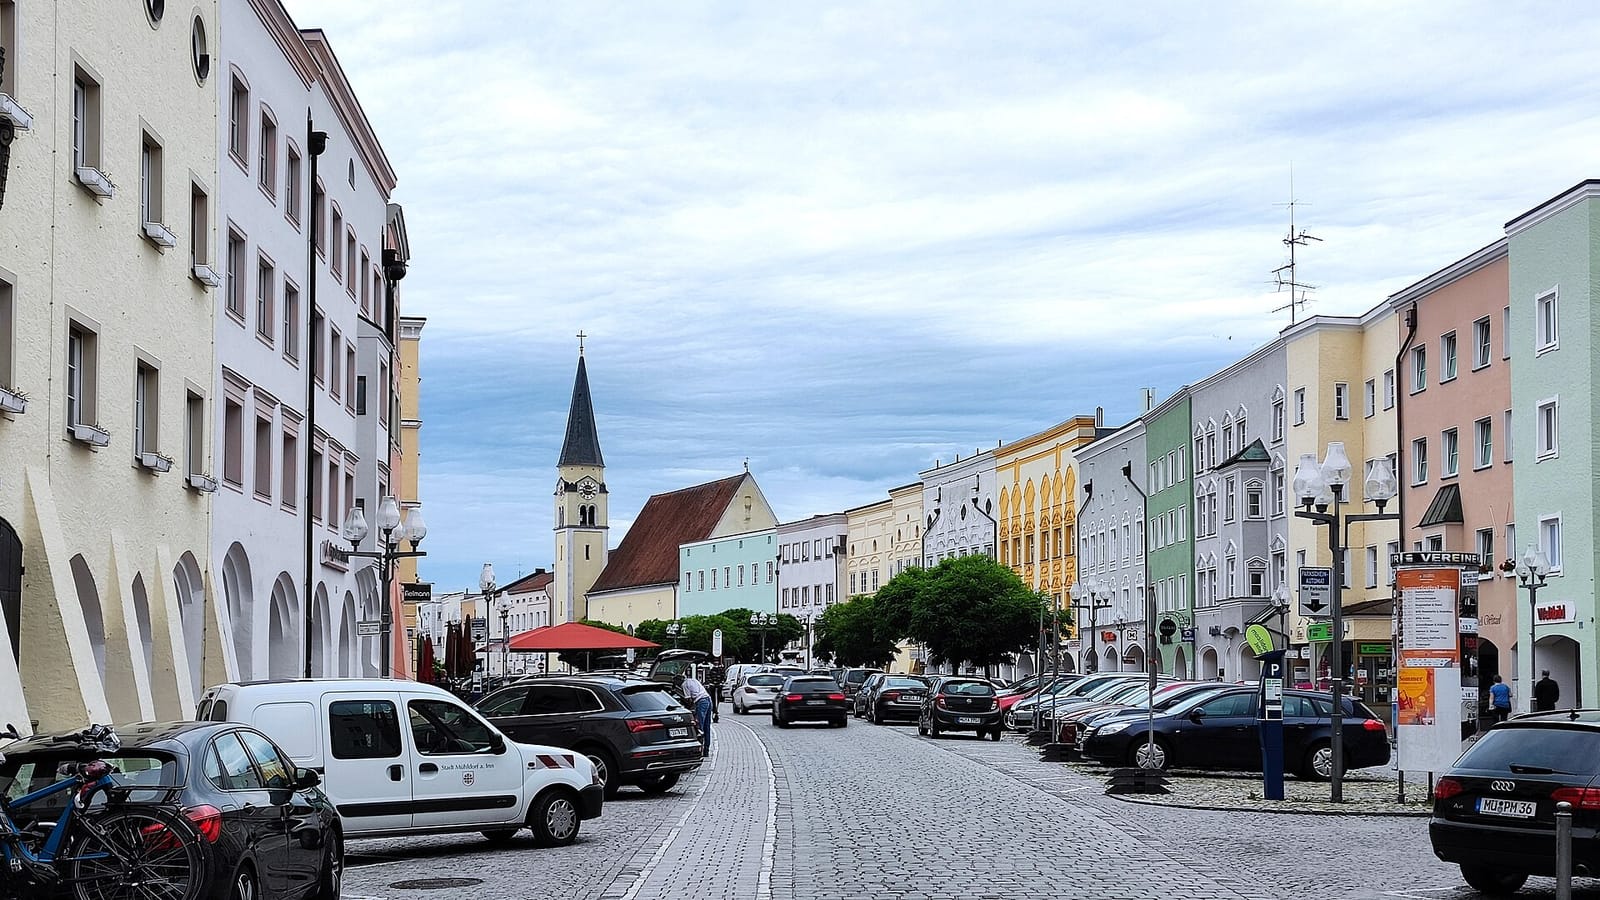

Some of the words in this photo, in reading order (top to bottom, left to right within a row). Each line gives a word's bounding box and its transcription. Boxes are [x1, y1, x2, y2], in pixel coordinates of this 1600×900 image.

[1420, 553, 1478, 564] VEREINE
[1537, 604, 1566, 621] Weltbild
[1271, 664, 1280, 676] P
[1503, 801, 1518, 814] PM
[1519, 803, 1533, 815] 36
